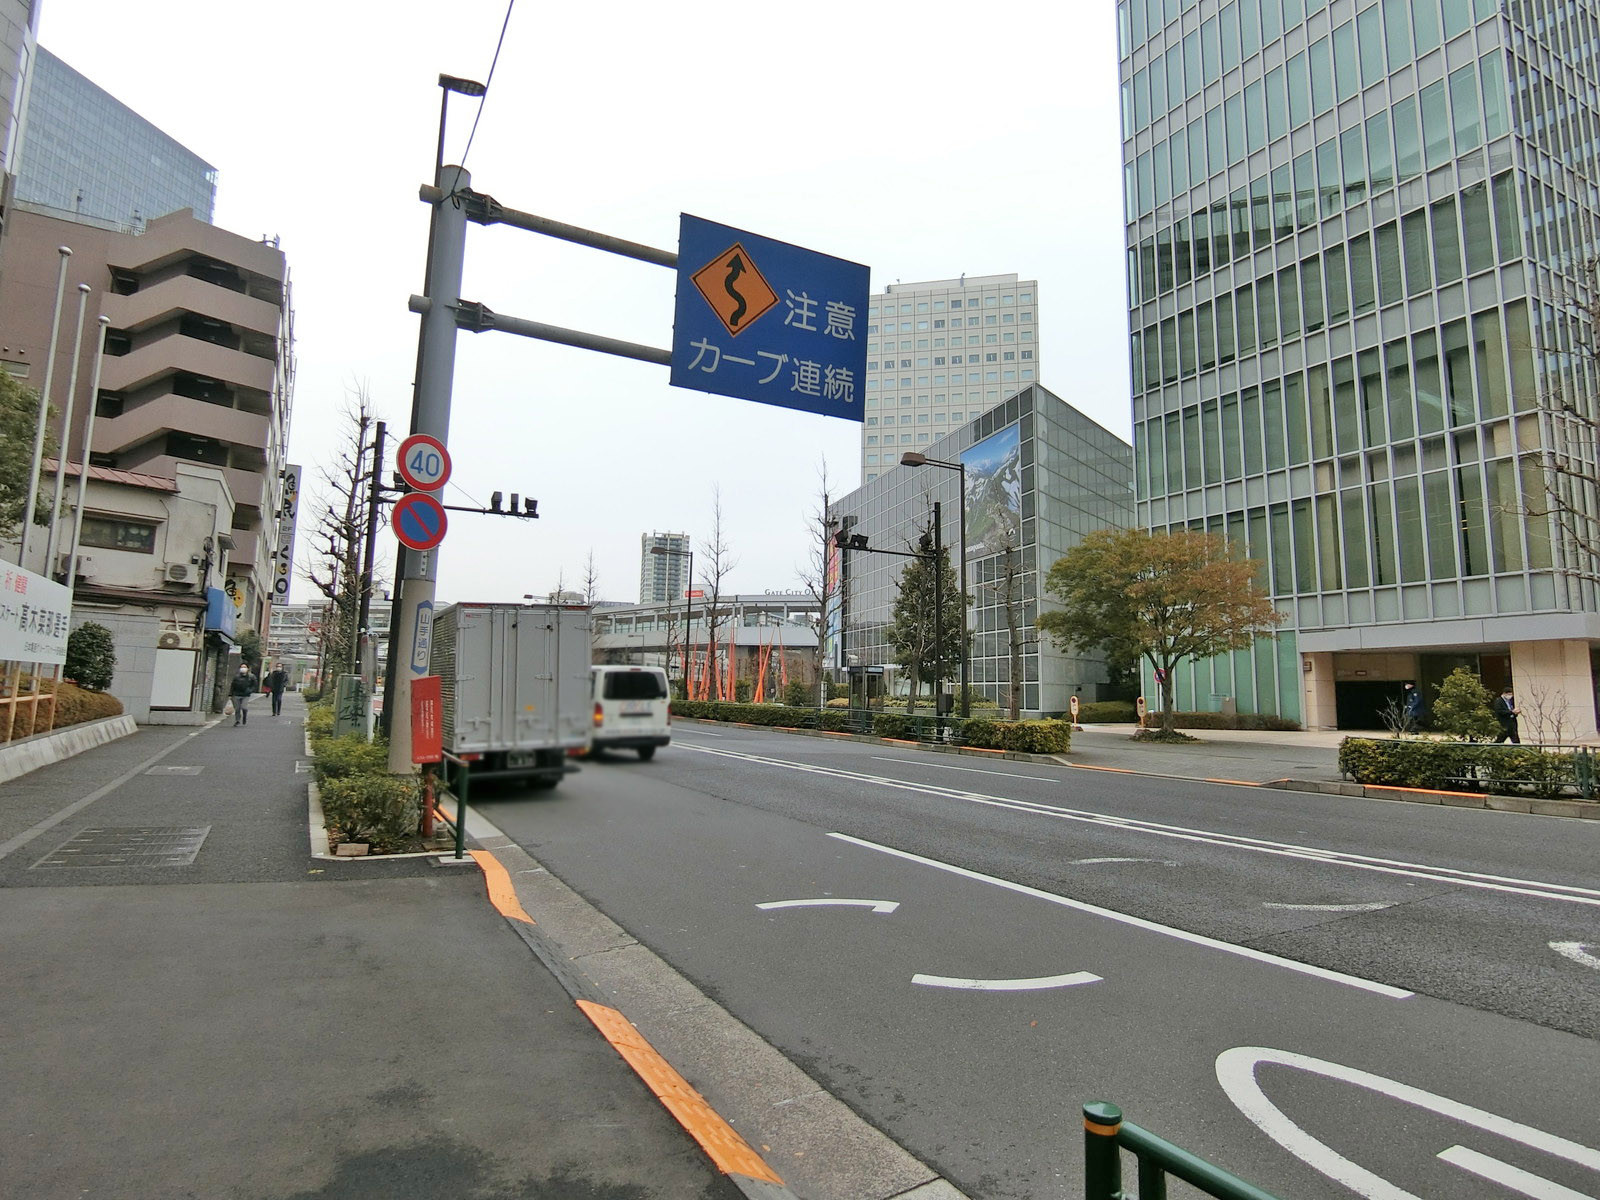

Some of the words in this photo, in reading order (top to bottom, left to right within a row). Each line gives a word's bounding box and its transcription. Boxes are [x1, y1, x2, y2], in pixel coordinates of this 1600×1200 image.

[784, 289, 857, 341] 注意
[687, 337, 855, 403] カーブ連続
[410, 450, 440, 477] 40
[416, 613, 430, 661] 山手通り
